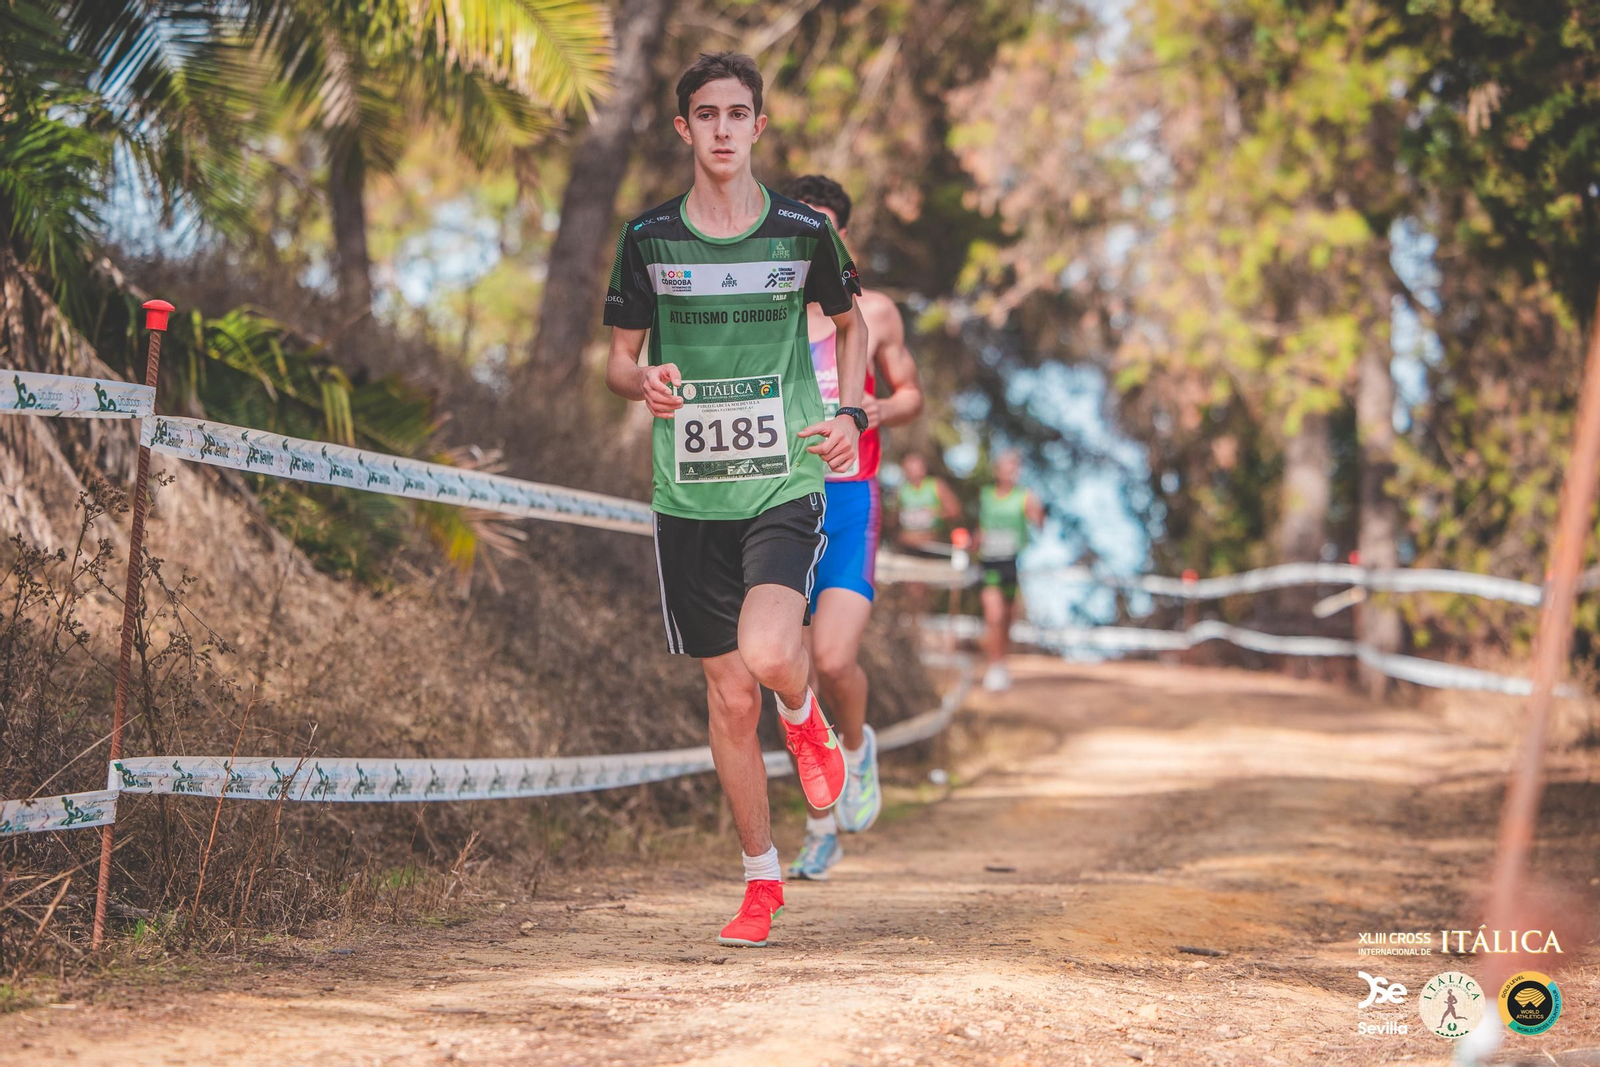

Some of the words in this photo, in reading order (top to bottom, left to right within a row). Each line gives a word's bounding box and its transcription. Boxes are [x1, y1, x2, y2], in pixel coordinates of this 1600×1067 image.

[778, 209, 820, 229] DECATHLON
[670, 310, 728, 325] ATLETISMO
[733, 305, 787, 323] CORDOBÉS
[702, 382, 753, 397] ITÁLICA
[684, 415, 778, 453] 8185
